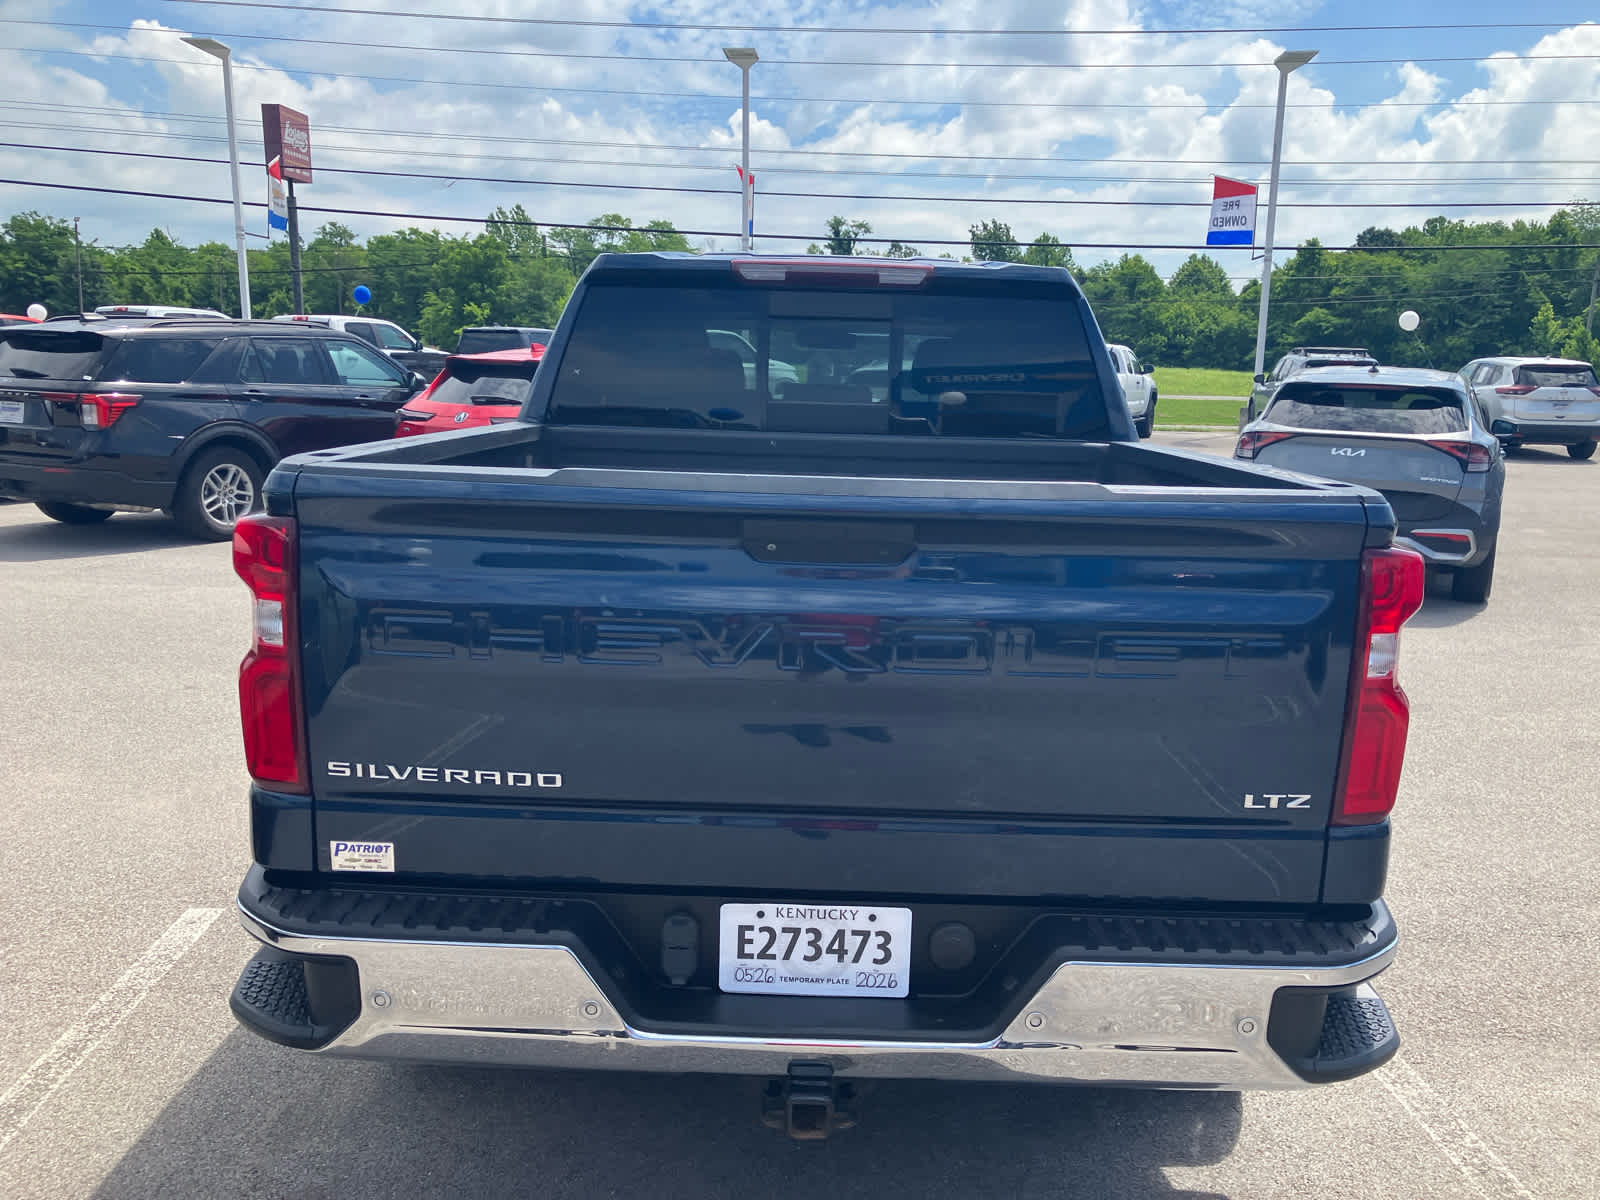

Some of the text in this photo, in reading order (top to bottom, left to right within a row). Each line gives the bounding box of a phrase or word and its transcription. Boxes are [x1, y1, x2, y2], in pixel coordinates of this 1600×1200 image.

[327, 761, 563, 788] SILVERADO
[1243, 793, 1312, 809] LTZ
[775, 907, 859, 921] KENTUCKY
[737, 924, 893, 966] E273473
[779, 975, 850, 986] TEMPORARY PLATE
[855, 971, 899, 990] 2026
